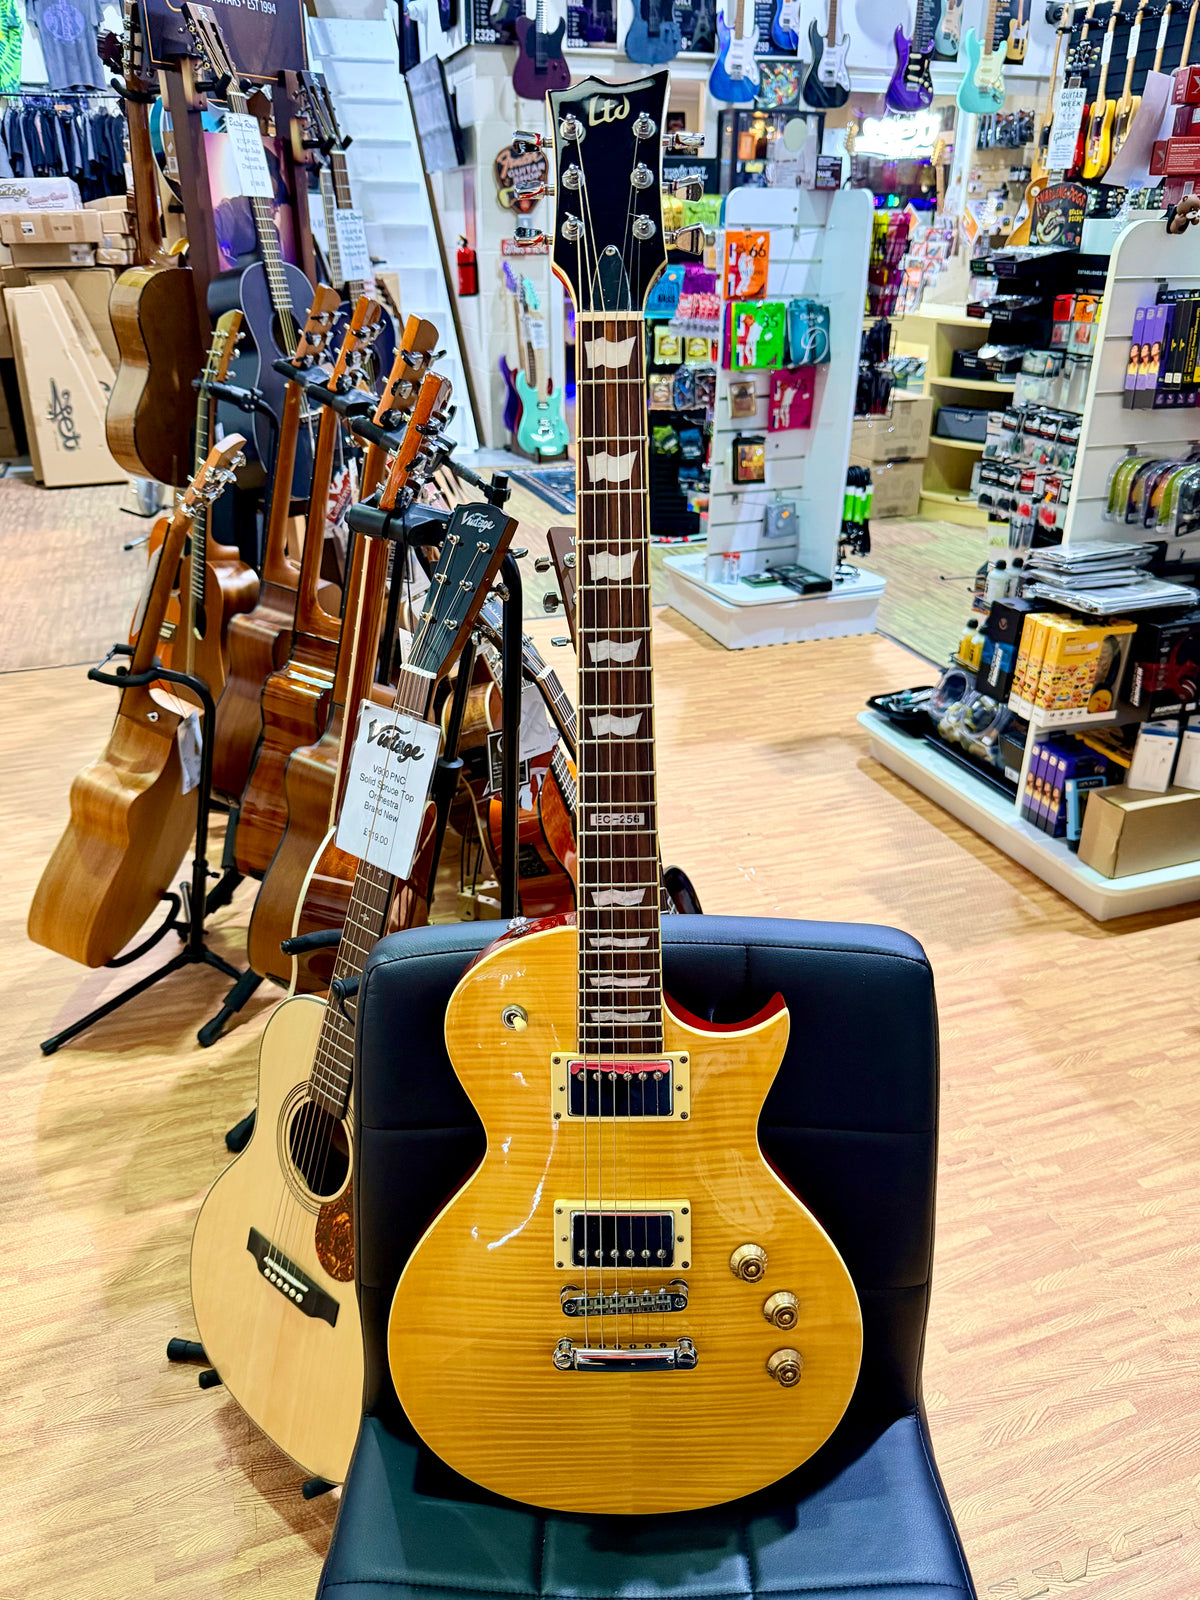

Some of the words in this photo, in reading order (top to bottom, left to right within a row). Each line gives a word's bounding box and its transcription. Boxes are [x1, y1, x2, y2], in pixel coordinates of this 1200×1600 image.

[247, 0, 259, 11] EST
[261, 1, 276, 15] 1994
[1062, 91, 1083, 100] GUITAR
[749, 244, 766, 258] 66
[461, 510, 495, 533] Vintage
[367, 719, 425, 763] Vintage
[359, 772, 376, 787] Solid
[376, 778, 399, 797] Spruce
[401, 790, 414, 804] Top
[368, 790, 399, 810] Orchestra
[364, 801, 384, 816] Brand
[384, 811, 399, 824] New
[595, 814, 640, 825] EC-256
